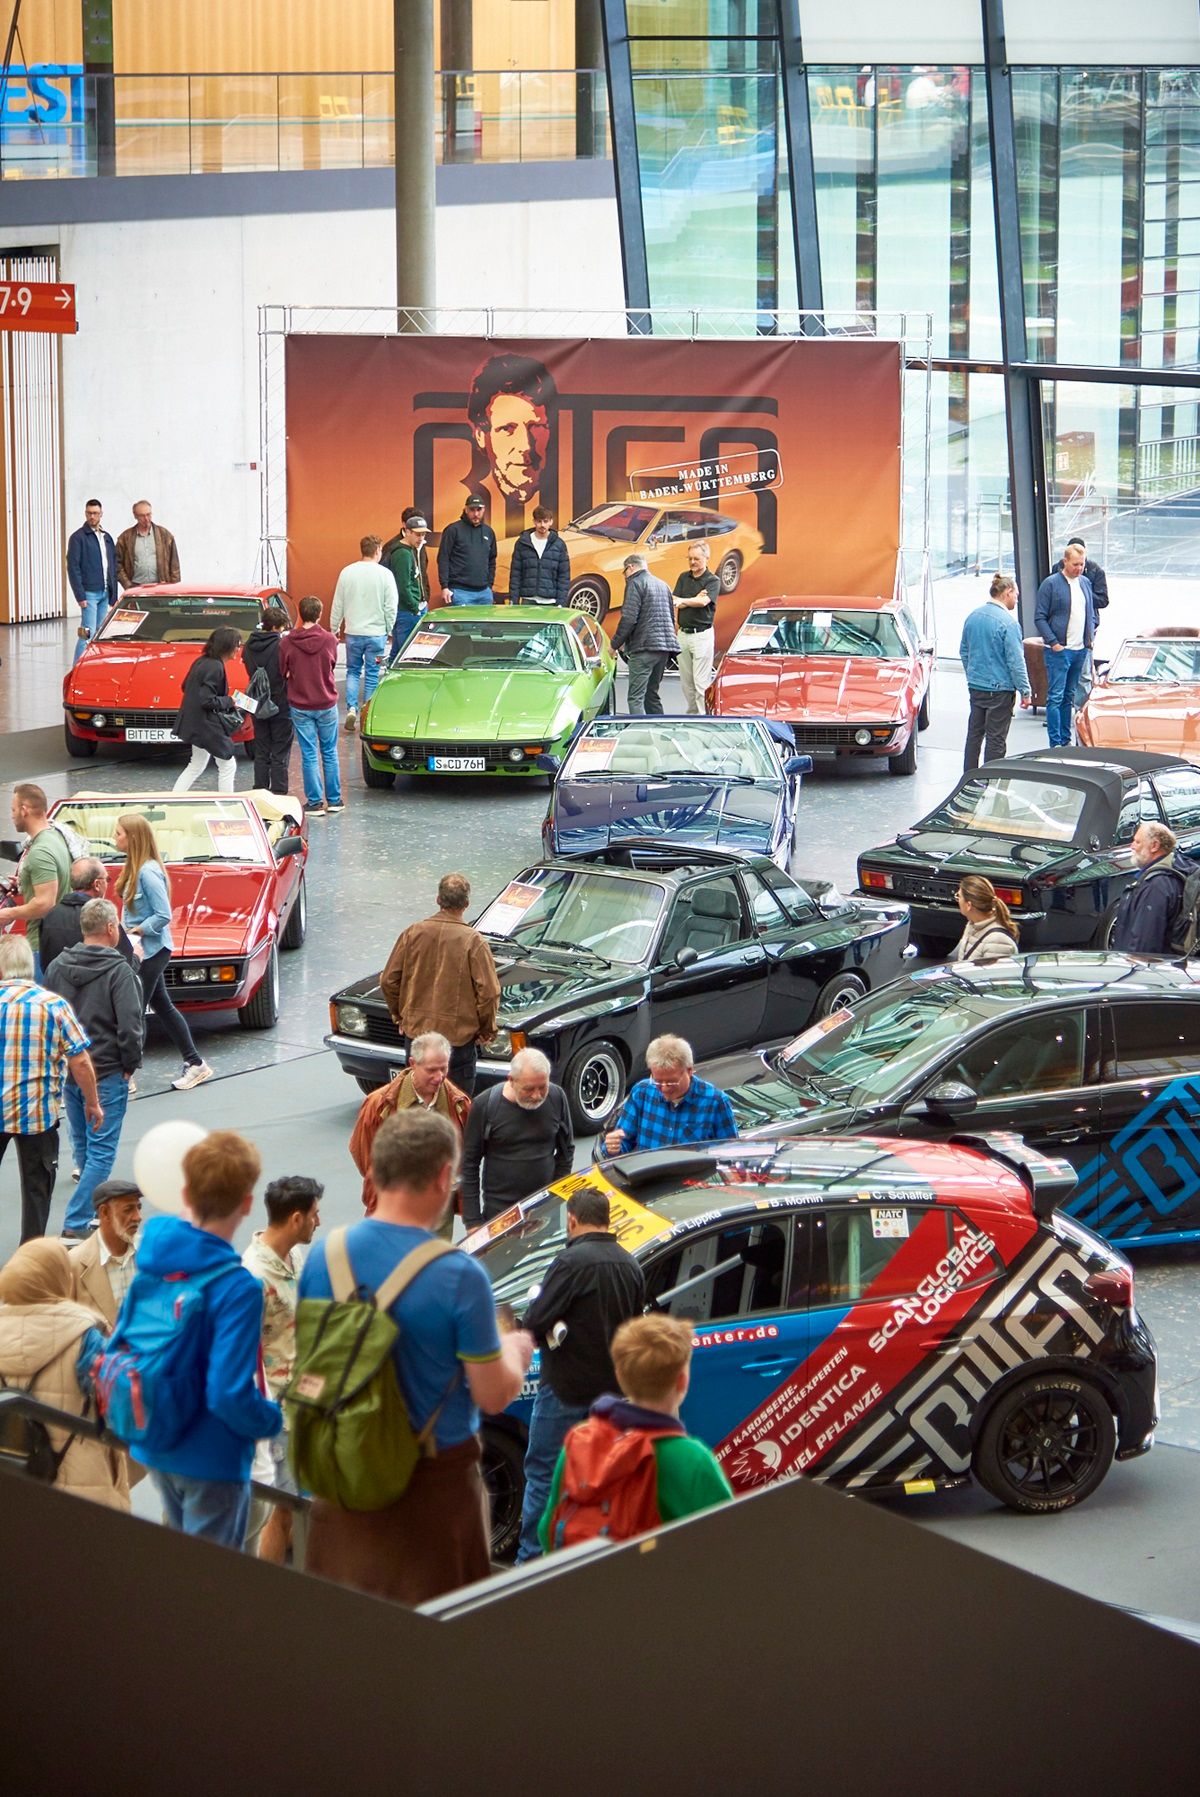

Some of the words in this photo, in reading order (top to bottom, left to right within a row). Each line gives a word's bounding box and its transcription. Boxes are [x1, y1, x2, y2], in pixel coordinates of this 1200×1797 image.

[678, 466, 712, 481] MADE
[715, 463, 729, 475] IN
[639, 469, 776, 500] BADEN-WÜRTTEMBERG
[128, 729, 165, 740] BITTER
[436, 759, 443, 769] S
[447, 759, 462, 769] CD
[464, 759, 484, 769] 76H
[770, 1199, 783, 1208] B.
[872, 1190, 886, 1200] C.
[879, 1210, 902, 1219] NATC
[670, 1226, 685, 1236] K.
[913, 1233, 996, 1325] LOGISTICS
[868, 1297, 922, 1354] SCAN
[917, 1229, 985, 1297] GLOBAL
[752, 1421, 775, 1442] UND
[775, 1346, 849, 1421] LACKEXPERTEN
[779, 1364, 867, 1447] IDENTICA
[715, 1444, 733, 1463] DIE
[733, 1384, 798, 1447] KAROSSERIE-
[815, 1382, 884, 1450] PFLANZE
